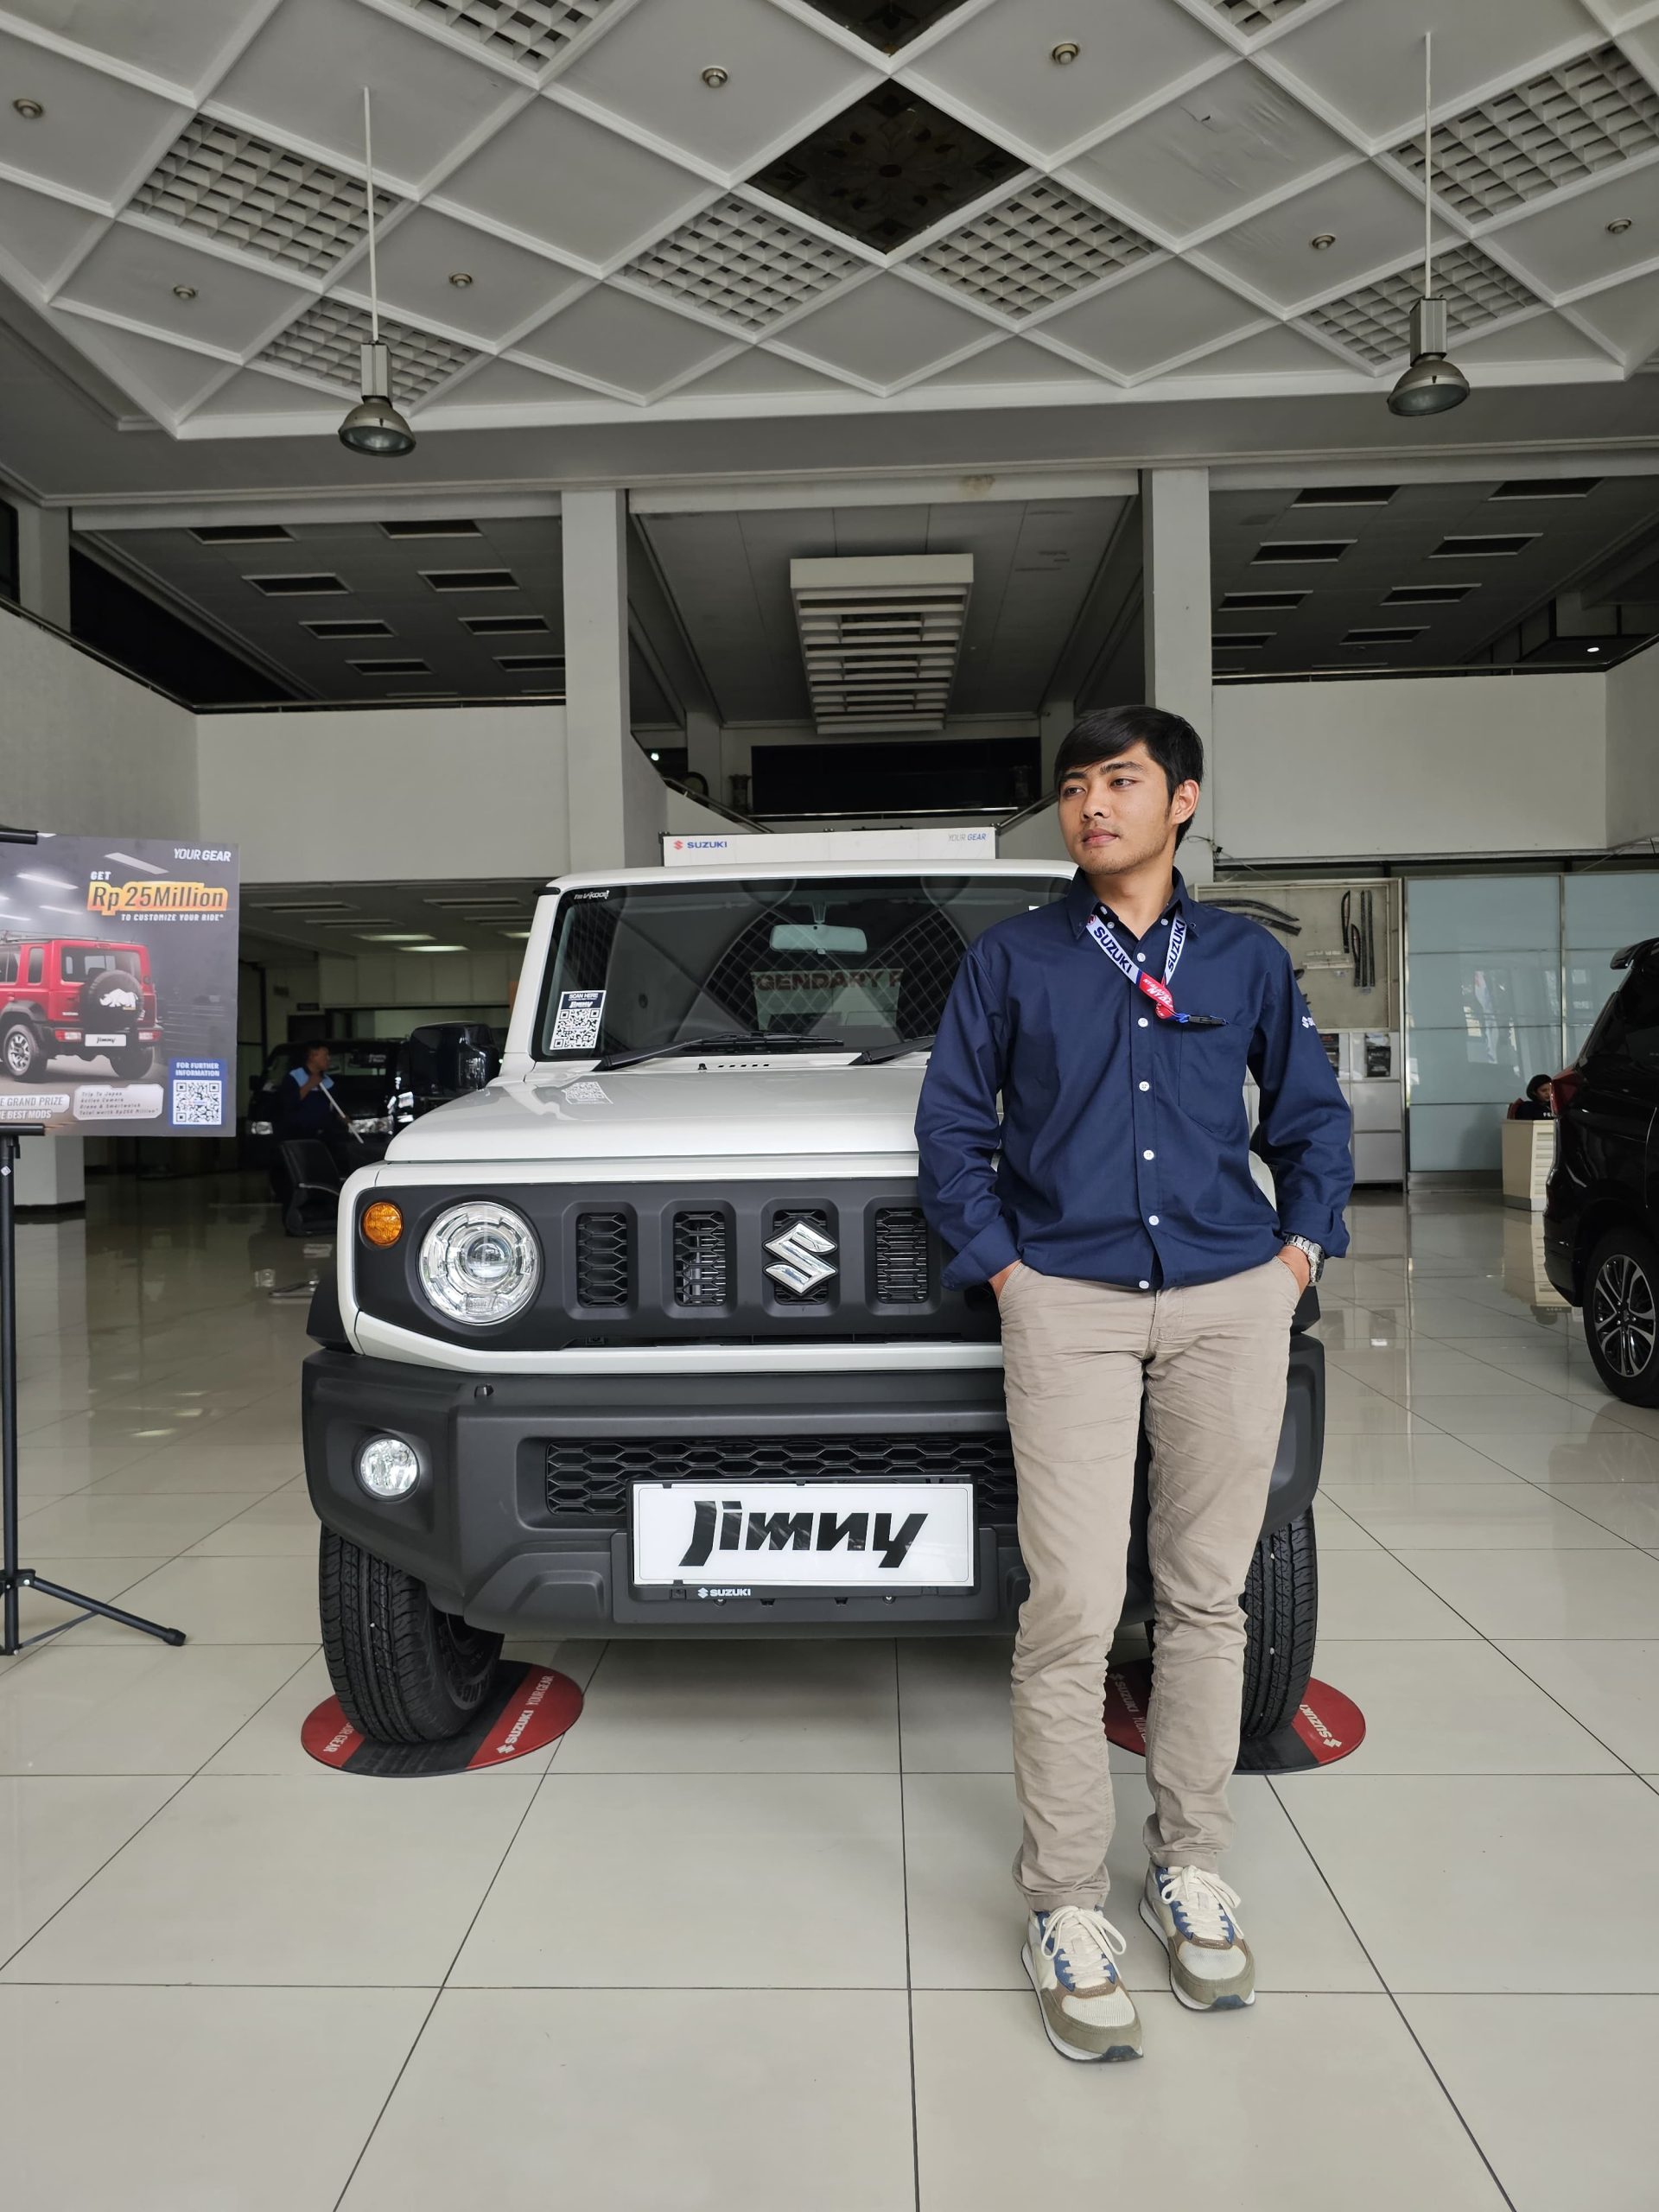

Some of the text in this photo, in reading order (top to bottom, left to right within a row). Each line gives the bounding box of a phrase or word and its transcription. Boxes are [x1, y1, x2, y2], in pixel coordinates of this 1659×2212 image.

[948, 833, 966, 842] YOUR
[174, 848, 232, 862] YOUR GEAR
[90, 871, 111, 880] GET
[92, 887, 119, 912] Rp
[133, 913, 177, 922] CUSTOMIZE
[179, 913, 200, 922] YOUR
[1093, 926, 1133, 974] SUZUKI
[1167, 919, 1185, 973] SUZUKI
[7, 1097, 36, 1107] GRAND
[39, 1096, 64, 1106] PRIZE
[7, 1109, 28, 1120] BEST
[28, 1109, 52, 1119] MODS
[677, 1500, 929, 1569] Jimny
[709, 1588, 751, 1597] SUZUKI
[1115, 1681, 1140, 1713] SUZUKI
[505, 1675, 555, 1744] SUZUKI YOUR GEAR
[1299, 1704, 1332, 1738] SUZUKI
[322, 1734, 348, 1752] GEAR
